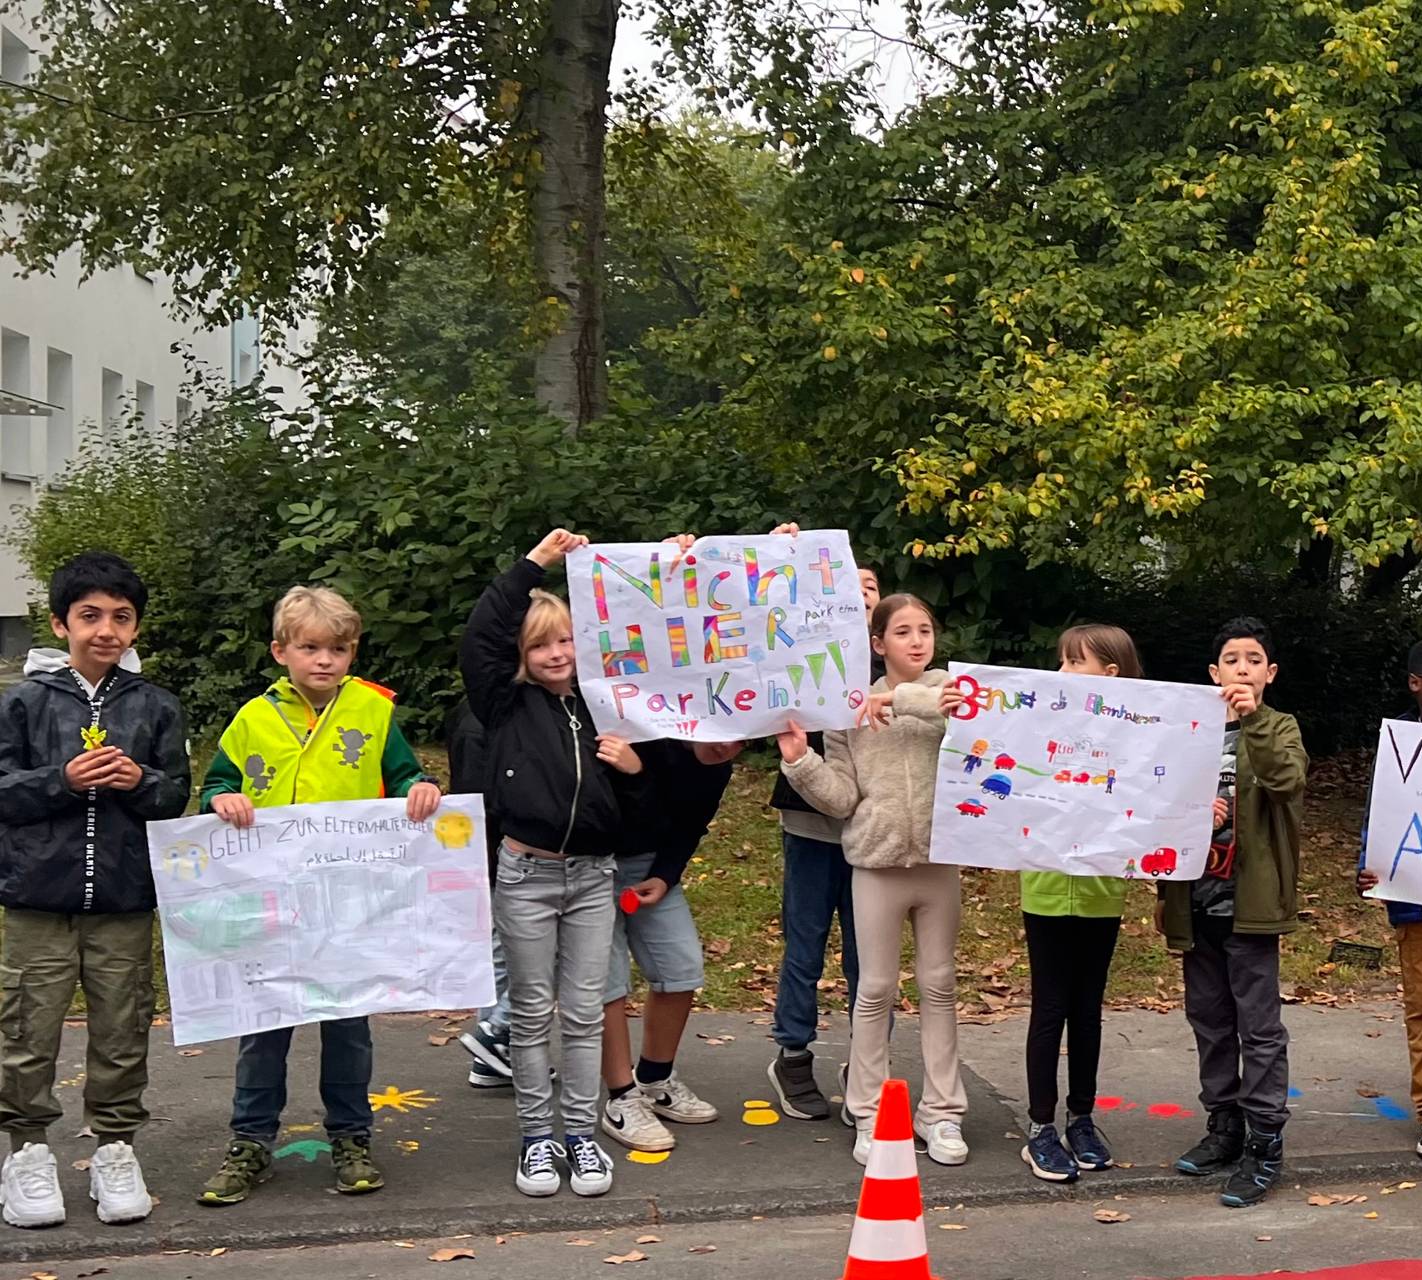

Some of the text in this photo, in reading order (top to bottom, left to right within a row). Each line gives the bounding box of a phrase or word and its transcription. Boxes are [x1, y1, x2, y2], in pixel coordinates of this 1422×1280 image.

[592, 547, 843, 624] Nicht
[598, 605, 795, 678] HIER
[209, 824, 266, 860] GEHT
[276, 817, 319, 843] ZUR
